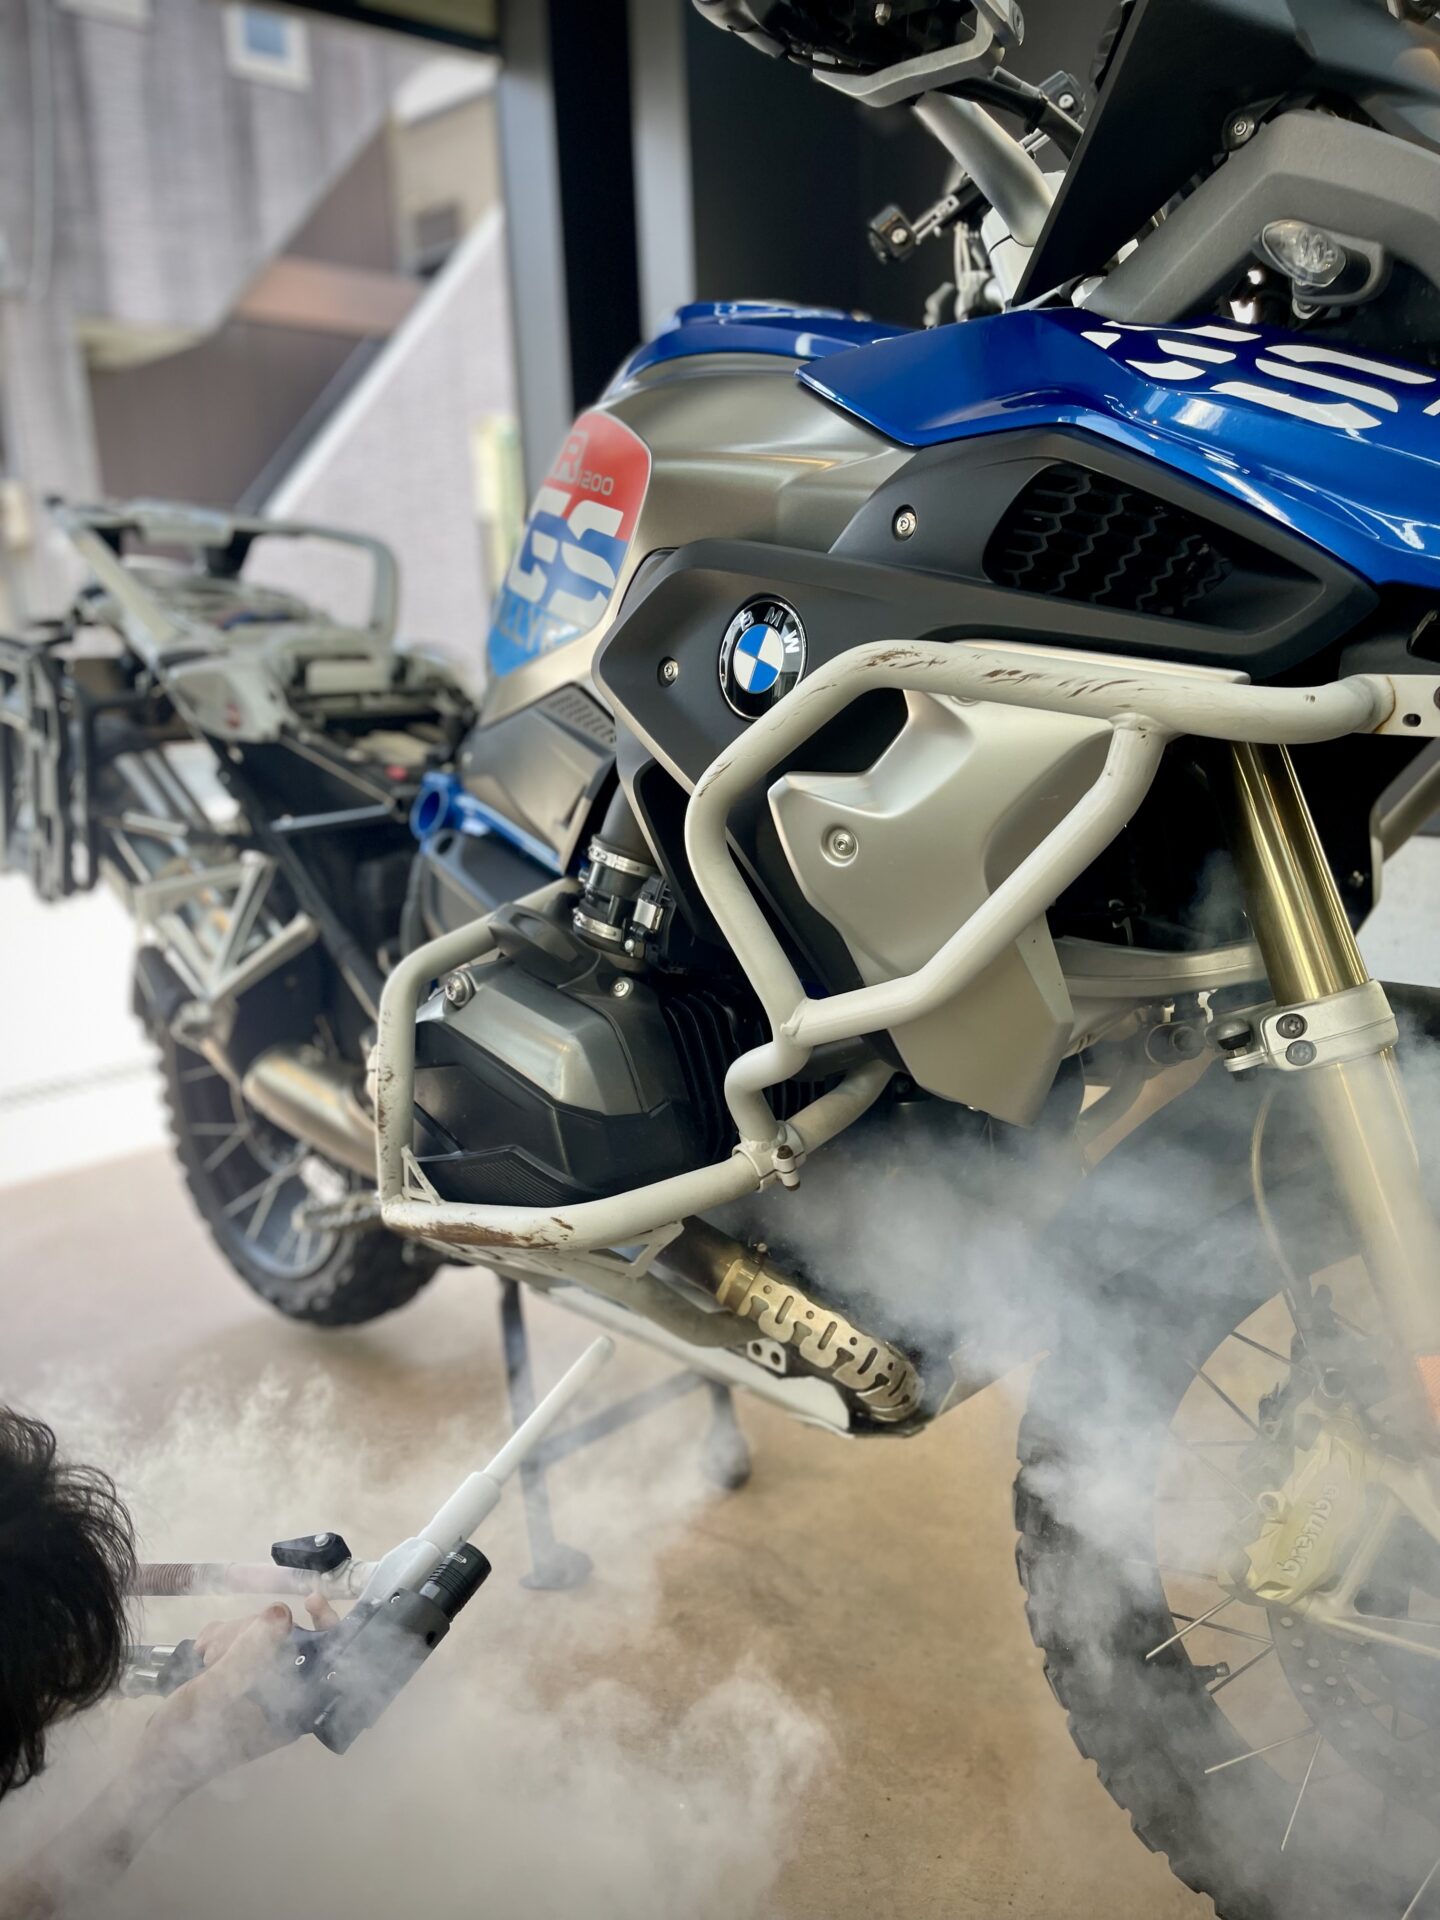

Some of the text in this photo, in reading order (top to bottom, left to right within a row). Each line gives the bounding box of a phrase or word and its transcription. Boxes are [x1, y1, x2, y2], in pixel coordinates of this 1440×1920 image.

[506, 486, 624, 630] GS
[740, 606, 800, 653] BMW
[1276, 1483, 1341, 1578] brembo
